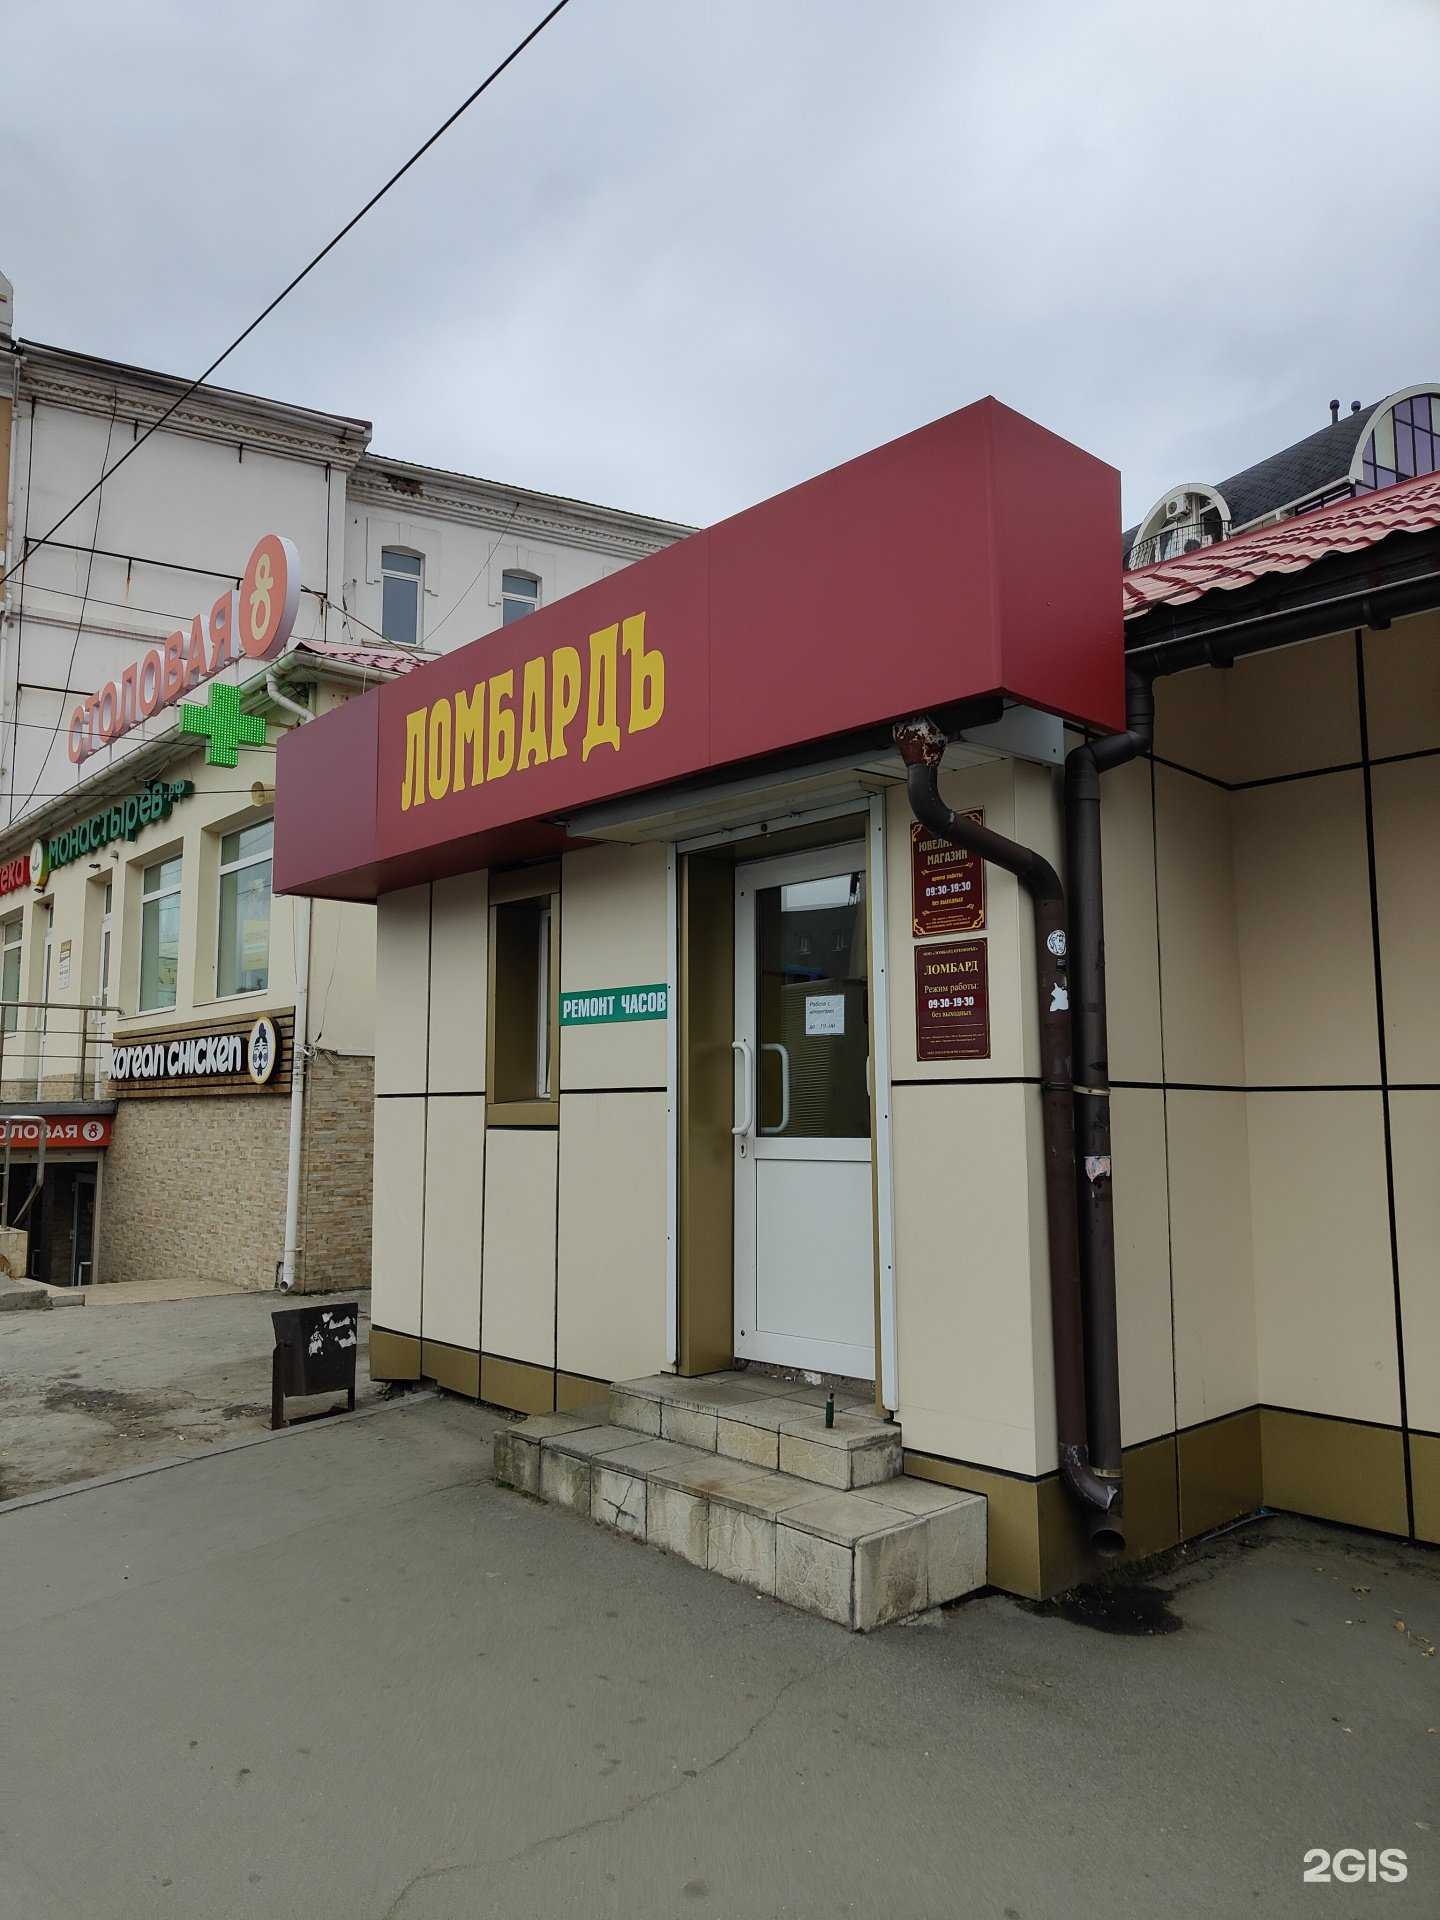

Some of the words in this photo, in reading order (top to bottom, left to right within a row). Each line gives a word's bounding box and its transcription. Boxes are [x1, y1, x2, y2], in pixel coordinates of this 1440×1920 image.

[67, 591, 235, 764] СТОЛОВАЯ
[401, 611, 666, 812] ЛОМБАРДЪ
[927, 849, 968, 865] МАГАЗИН
[0, 860, 24, 891] ека
[923, 960, 979, 976] ЛОМБАРД
[924, 984, 948, 993] Режим
[563, 996, 615, 1019] РЕМОНТ
[621, 991, 667, 1014] ЧАСОВ
